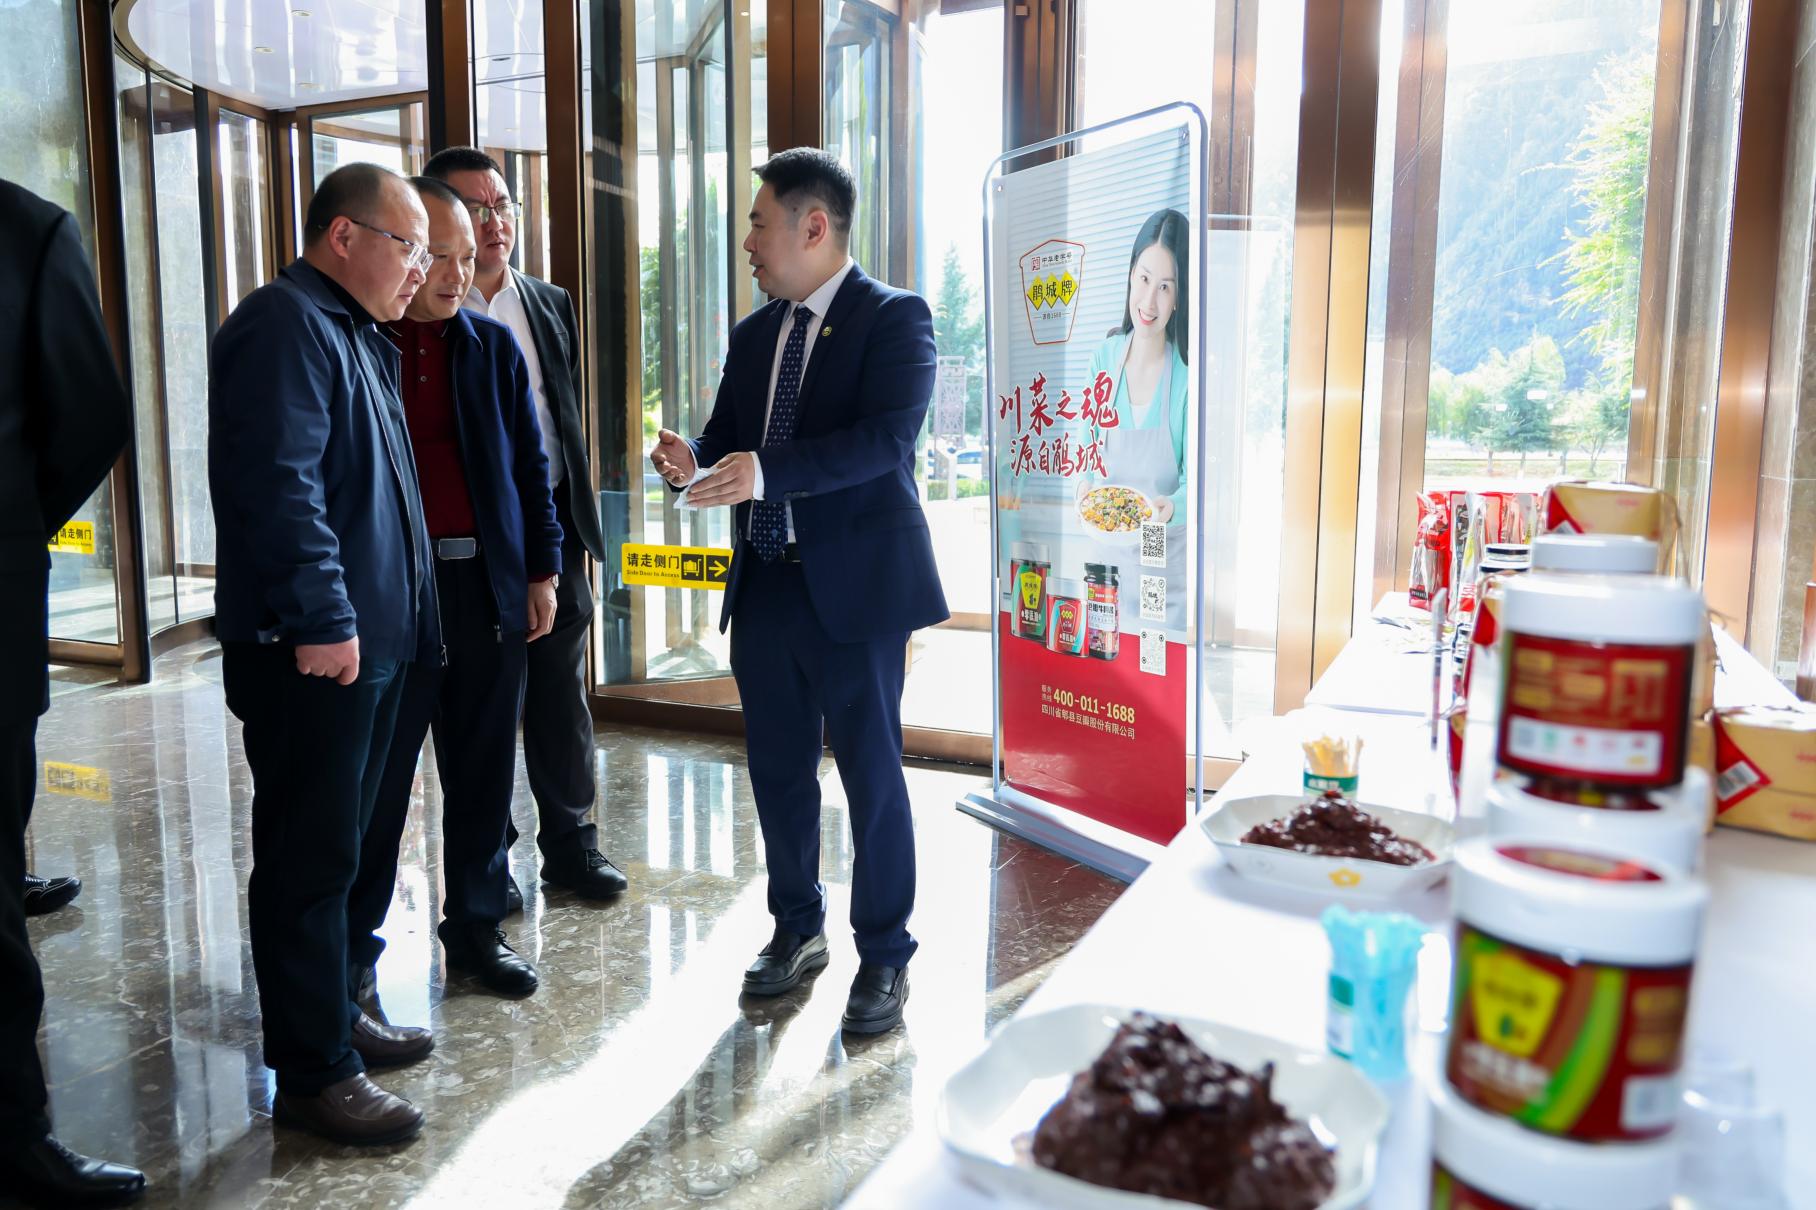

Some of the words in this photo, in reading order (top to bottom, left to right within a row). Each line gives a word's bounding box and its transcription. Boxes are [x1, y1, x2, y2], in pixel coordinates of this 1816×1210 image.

[1033, 280, 1073, 300] 鹃城牌
[1000, 372, 1119, 436] 川菜之魂
[1011, 429, 1107, 477] 源自鹃城
[627, 553, 680, 569] 请走侧门
[1042, 704, 1135, 740] 四川省郫县豆瓣股份有限公司
[1053, 688, 1135, 724] 400-011-1688
